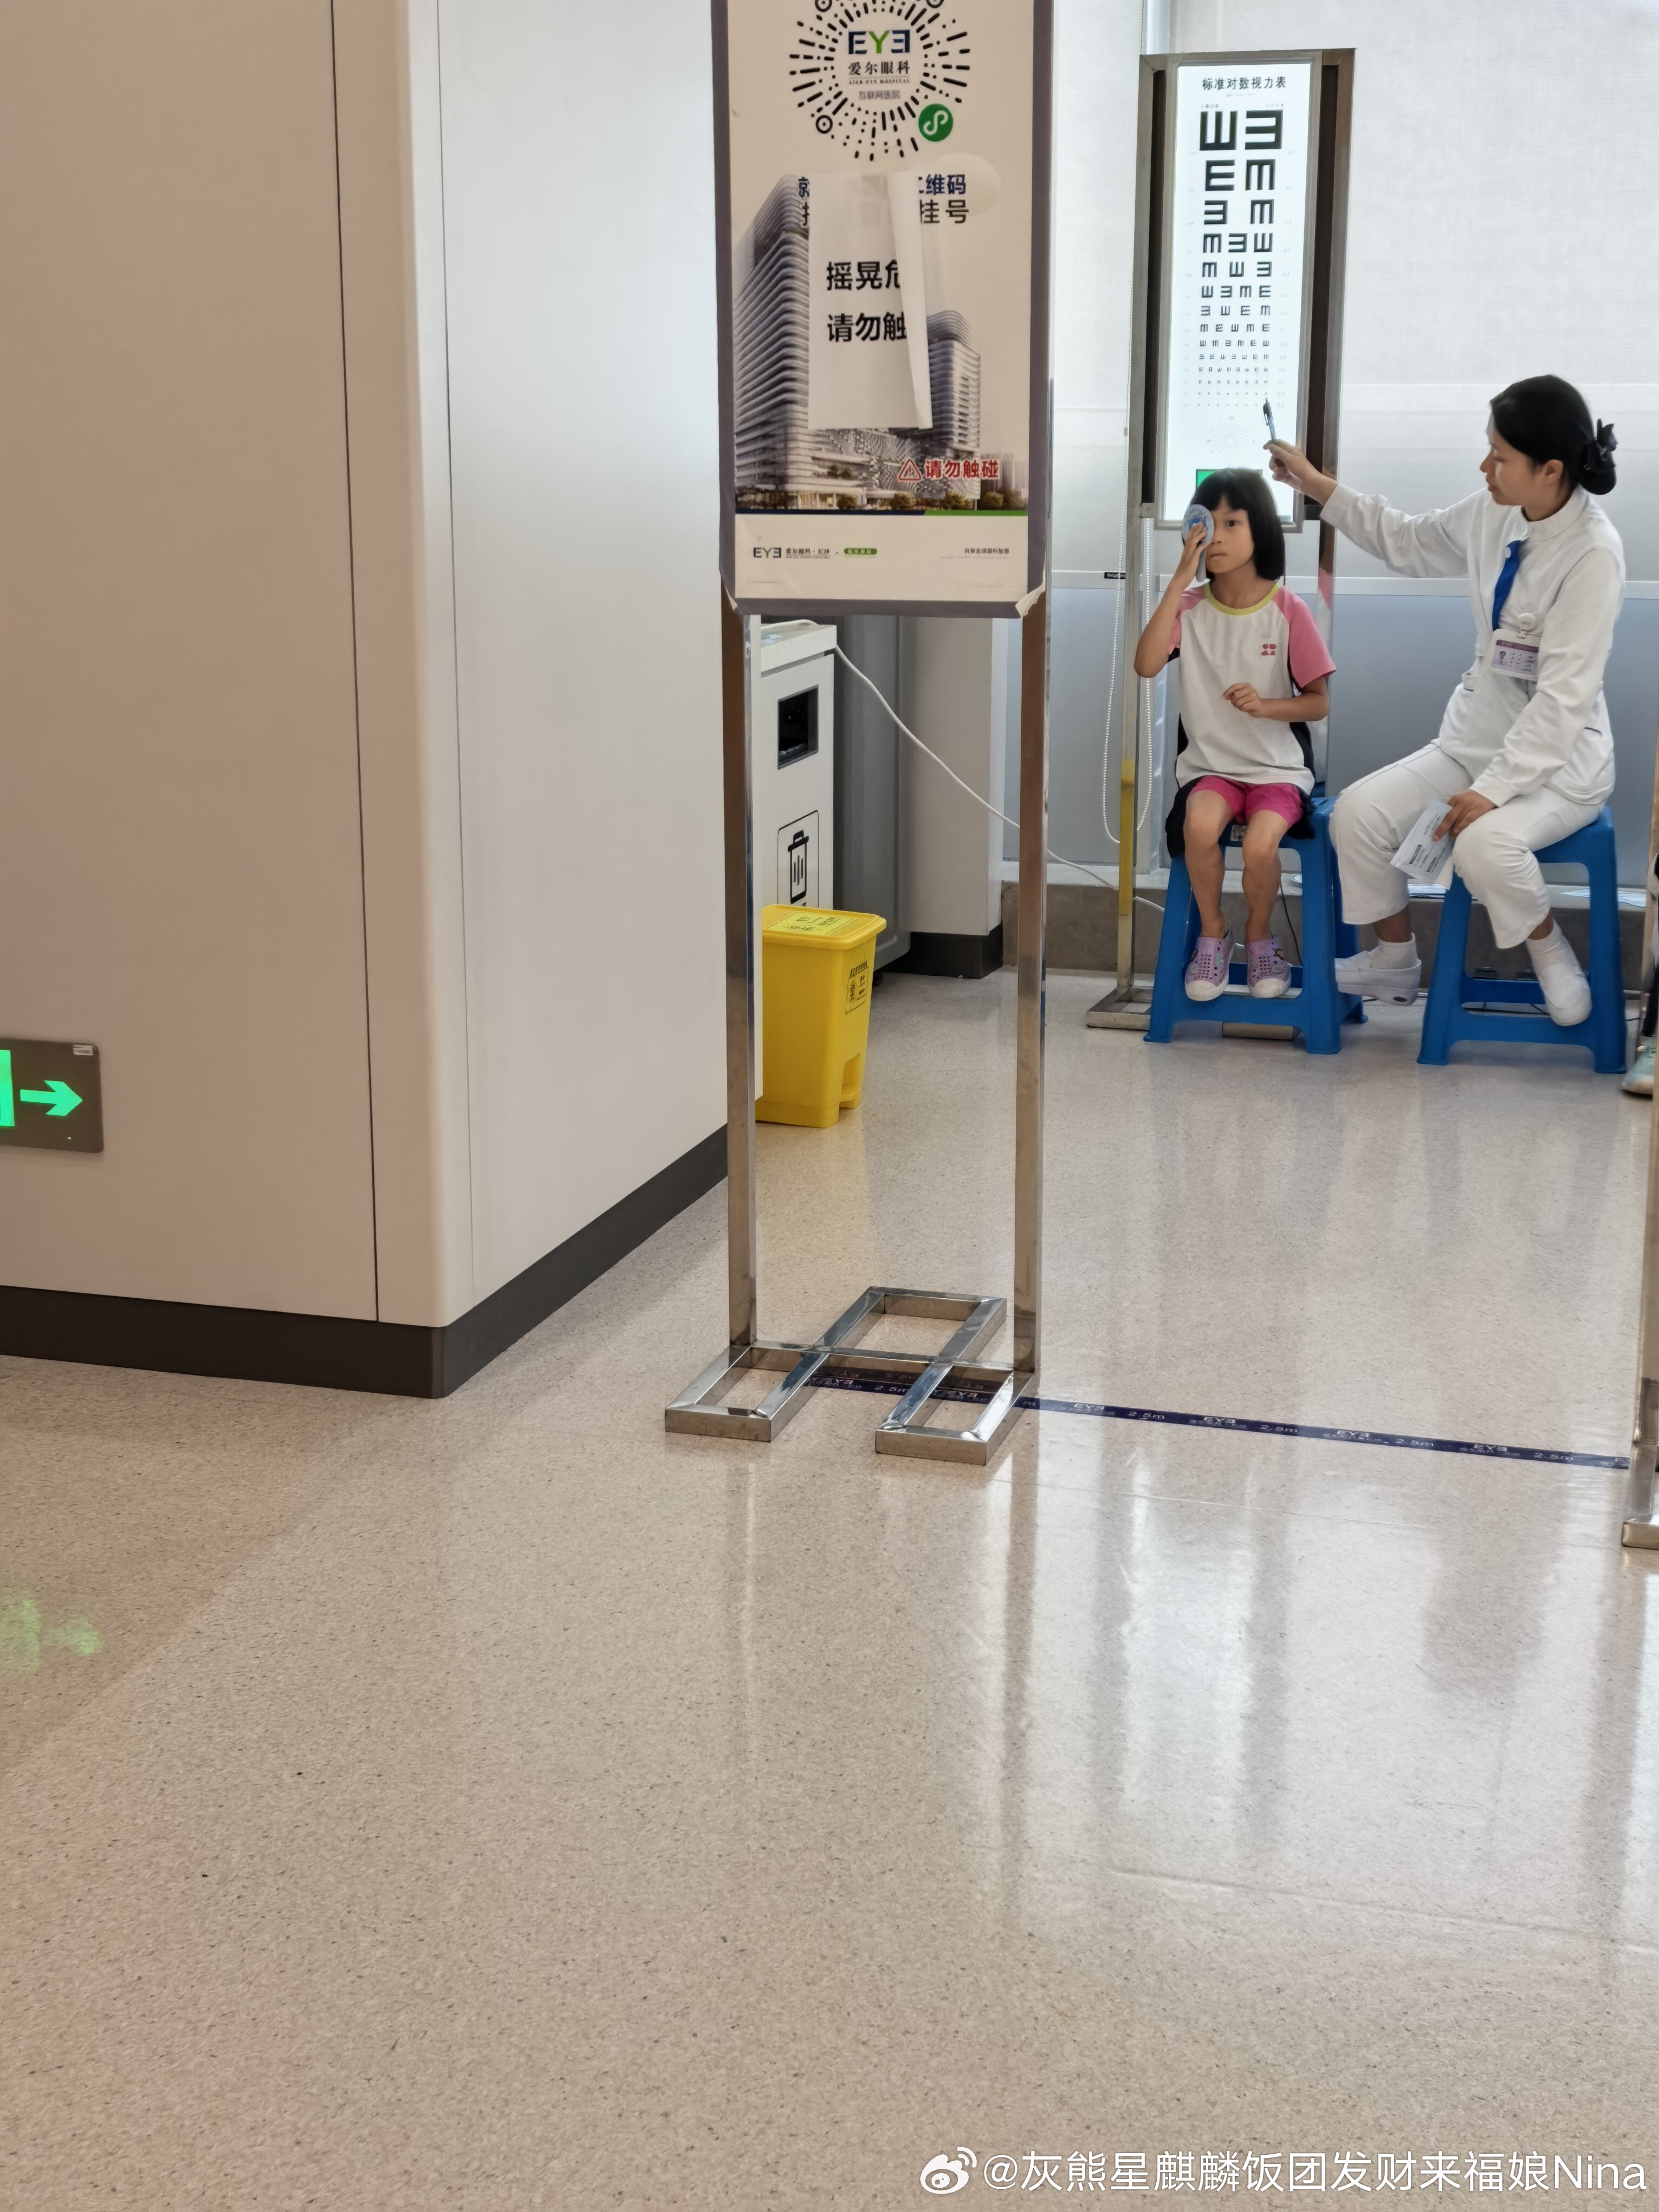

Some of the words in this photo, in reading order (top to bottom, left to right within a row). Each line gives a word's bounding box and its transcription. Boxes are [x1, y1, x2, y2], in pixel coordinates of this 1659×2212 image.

[848, 60, 911, 76] 爱尔眼科
[1202, 76, 1286, 91] 标准对数视力表
[919, 174, 966, 195] 维码
[926, 459, 999, 478] 请勿触碰
